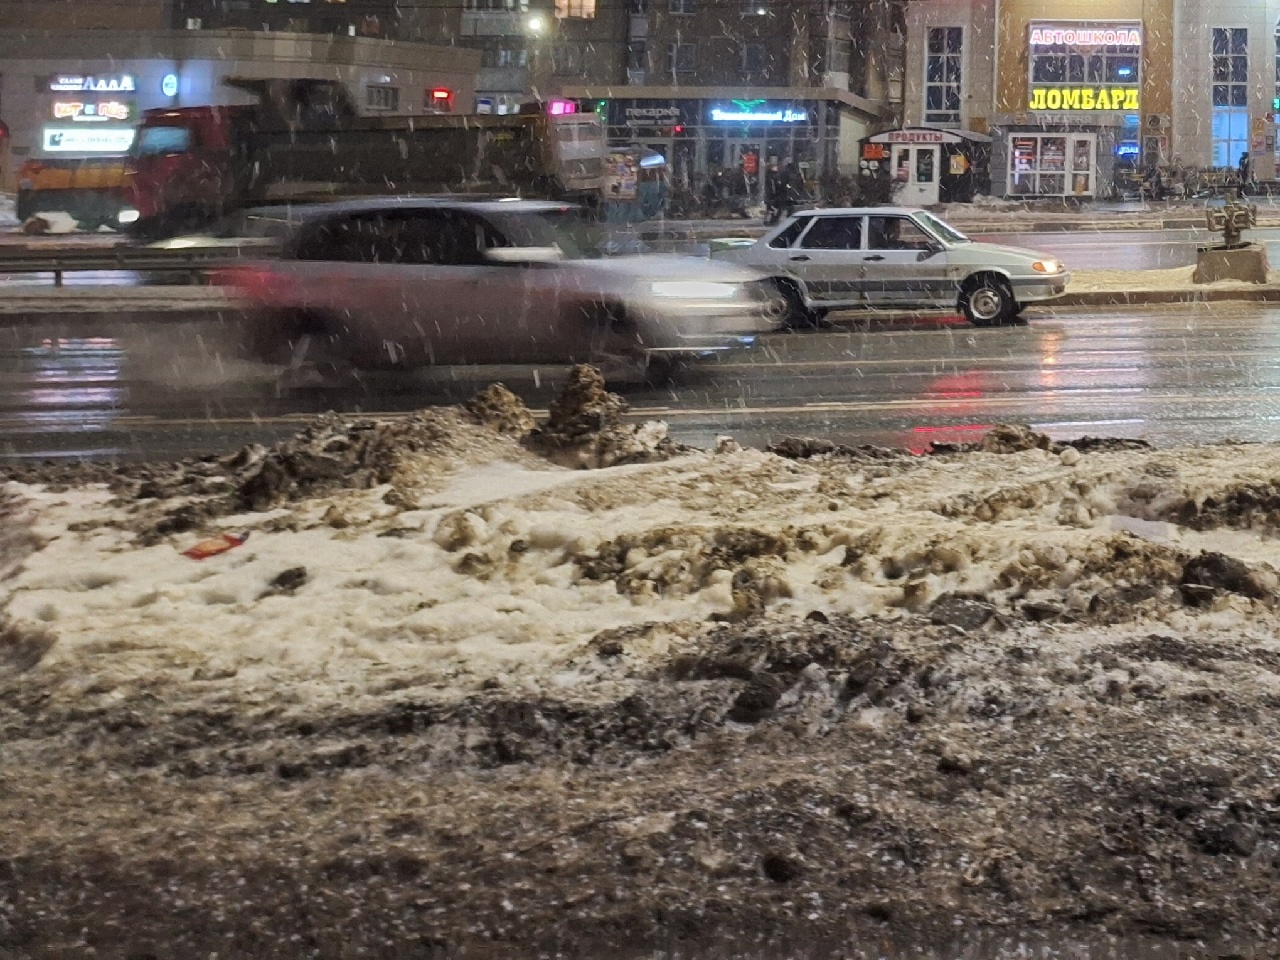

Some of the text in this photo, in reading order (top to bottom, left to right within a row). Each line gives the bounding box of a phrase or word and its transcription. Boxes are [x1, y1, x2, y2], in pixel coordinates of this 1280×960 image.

[1030, 29, 1141, 45] АВТОШКОЛА
[1029, 88, 1139, 110] ЛОМБАРД
[888, 132, 943, 142] ПРОДУКТЫ
